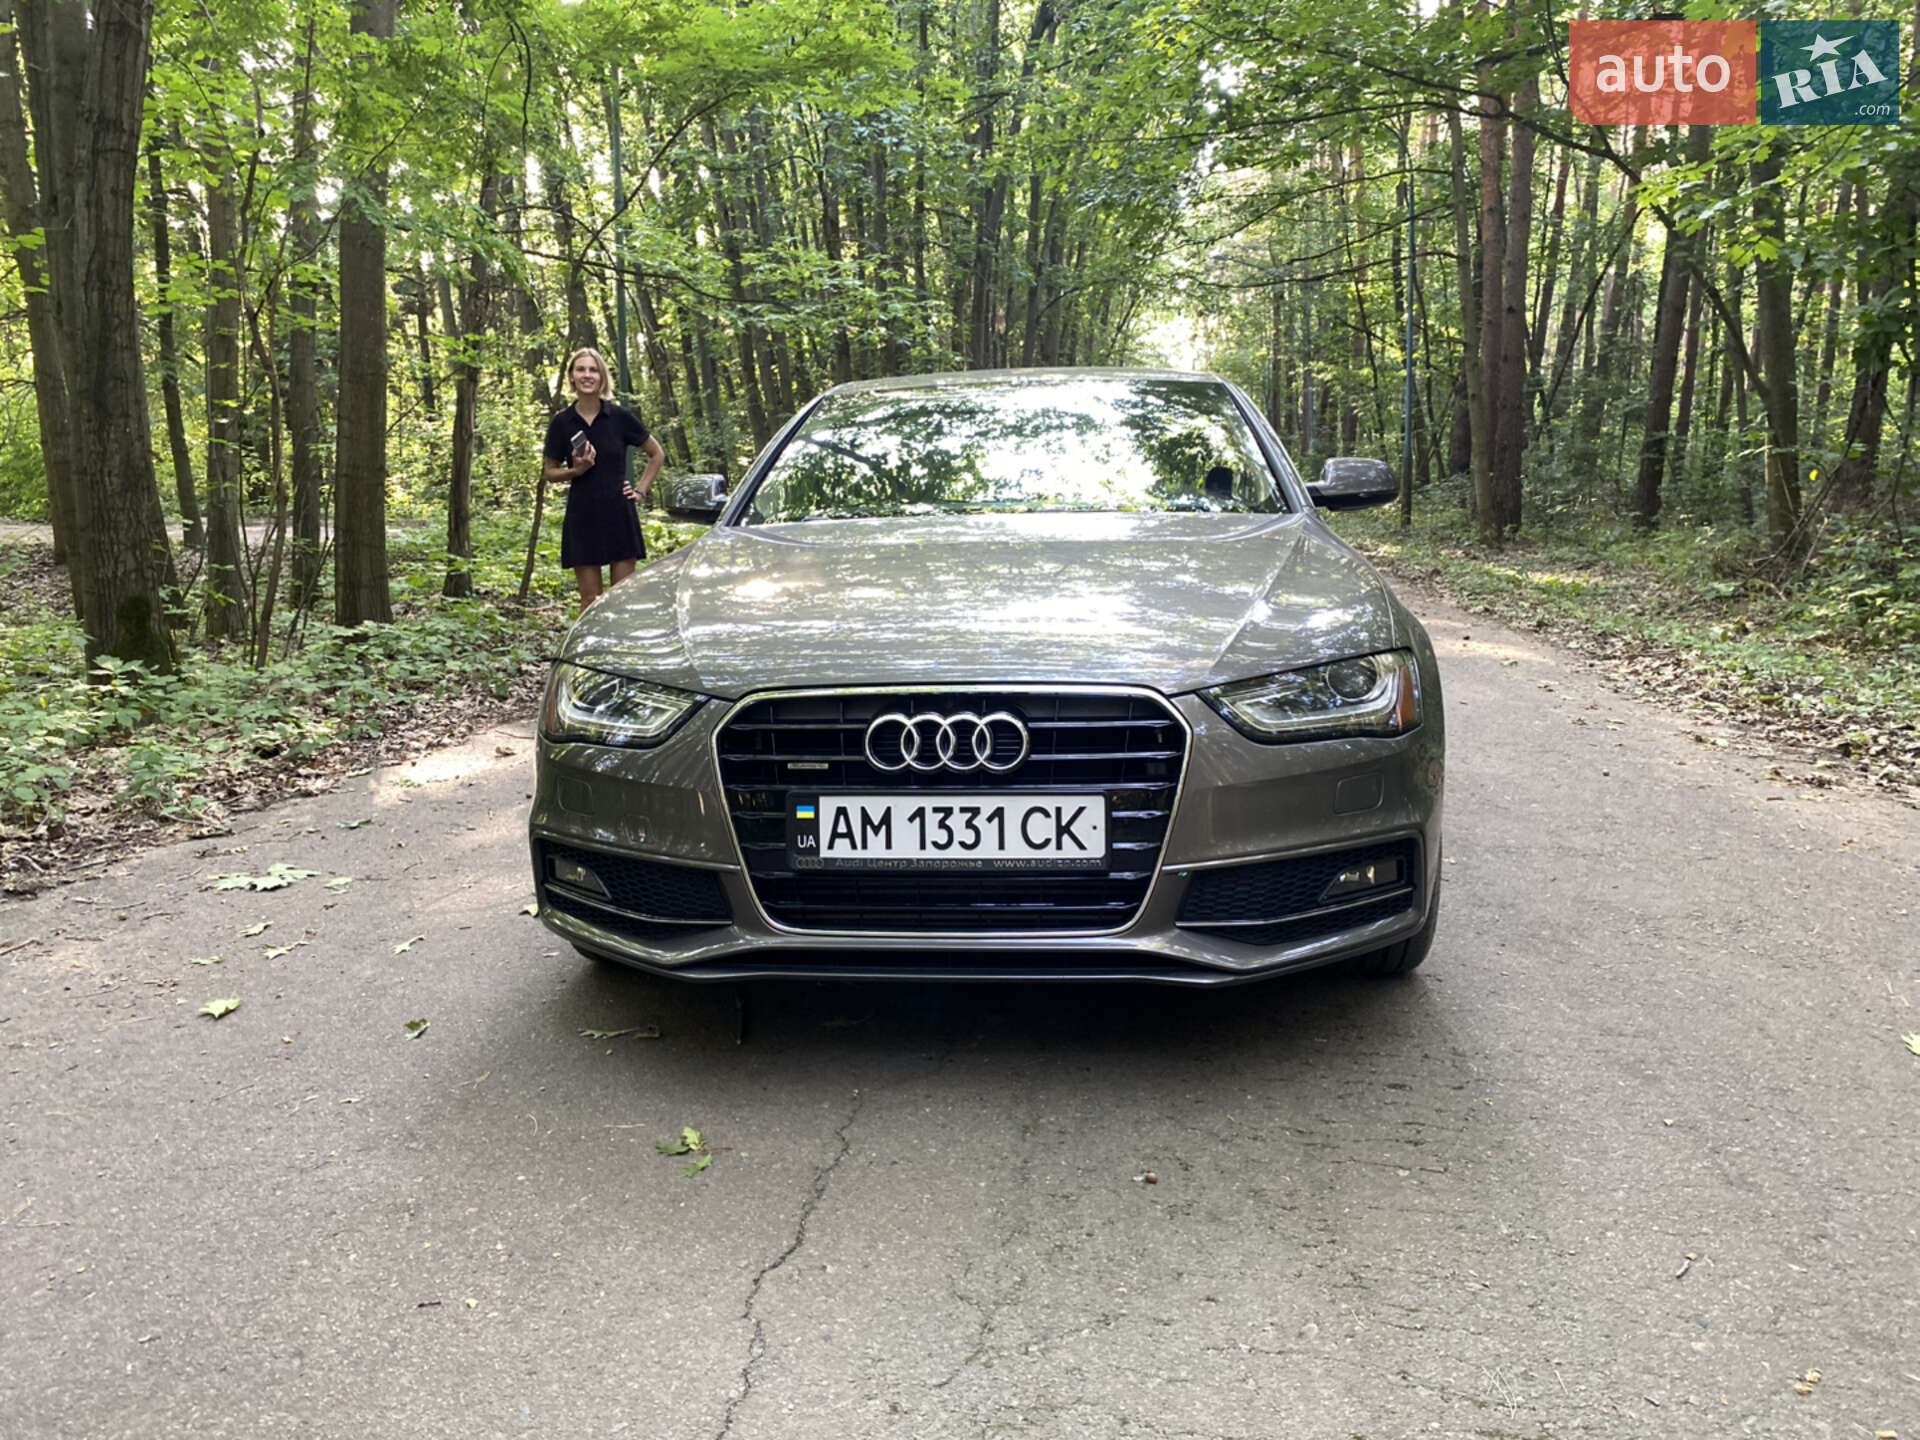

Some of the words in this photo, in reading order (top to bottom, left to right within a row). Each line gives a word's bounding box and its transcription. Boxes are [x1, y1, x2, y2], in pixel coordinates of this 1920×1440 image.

[827, 806, 892, 851] AM
[907, 806, 1005, 851] 1331
[1021, 806, 1088, 851] CK
[797, 835, 816, 849] UA
[835, 858, 863, 868] Audi
